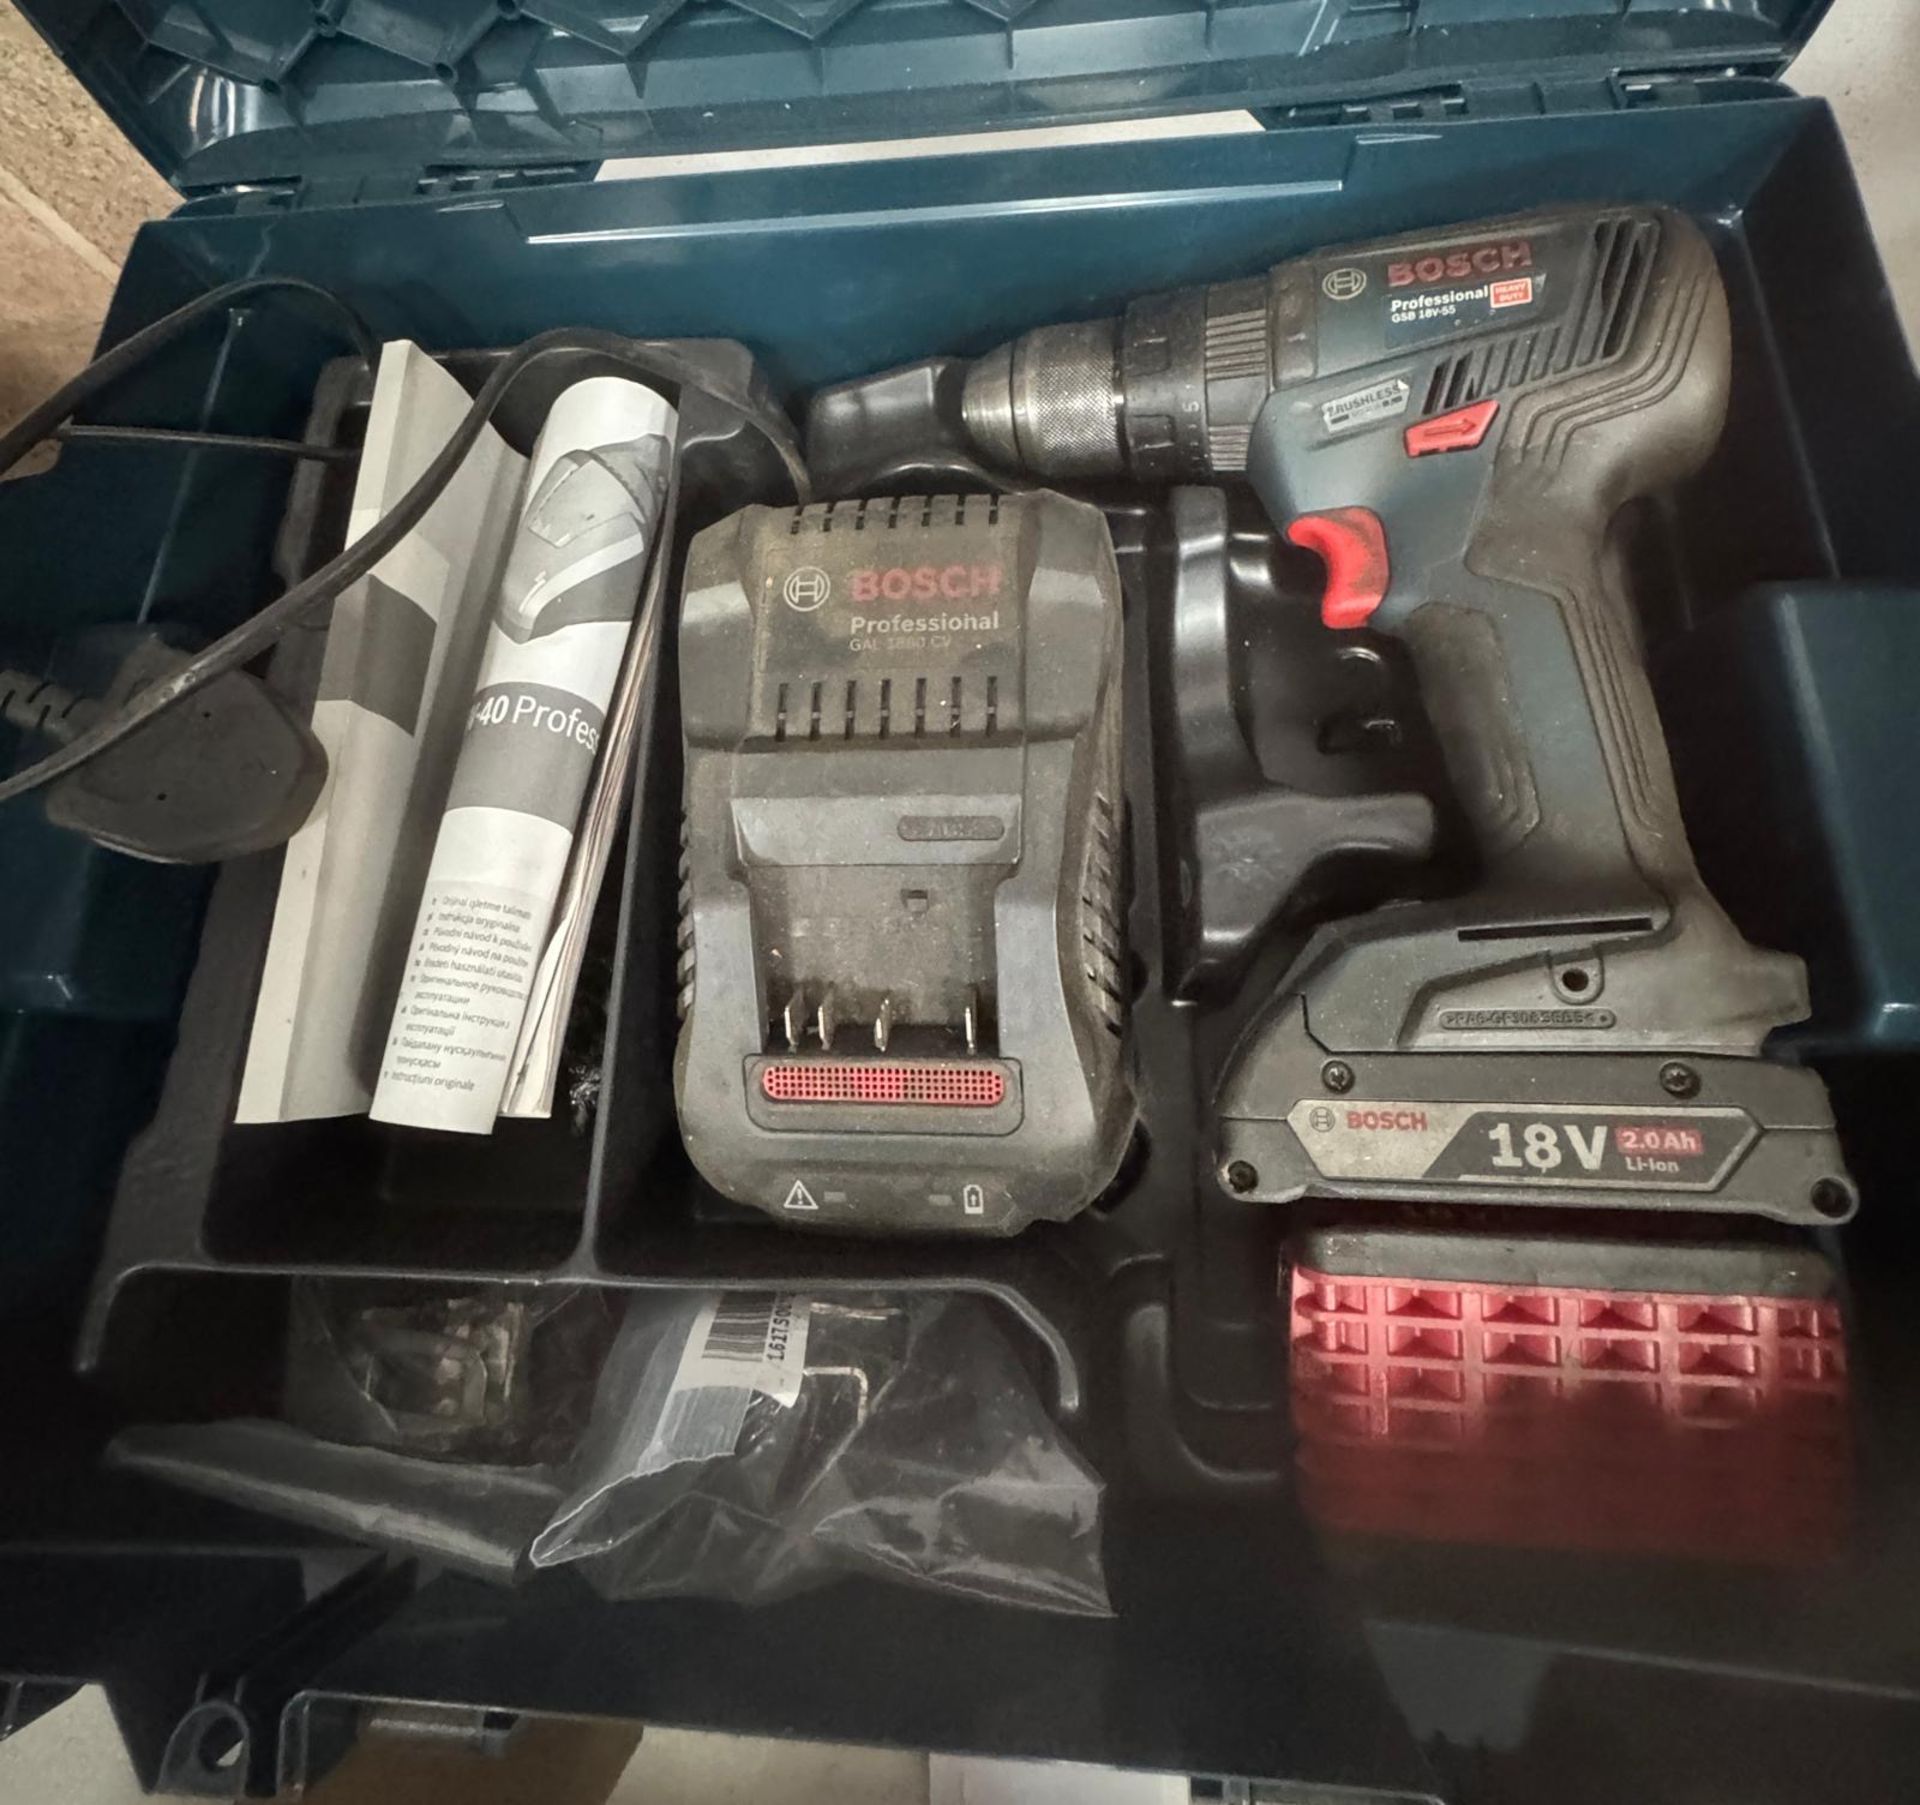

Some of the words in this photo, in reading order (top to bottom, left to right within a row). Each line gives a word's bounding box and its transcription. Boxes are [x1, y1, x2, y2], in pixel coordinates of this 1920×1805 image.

[1387, 241, 1532, 287] BOSCH
[1390, 285, 1488, 312] Professional
[1391, 310, 1416, 323] GSB
[1418, 304, 1456, 319] 18V-55
[851, 562, 1002, 602] BOSCH
[851, 611, 999, 635] Professional
[1345, 1110, 1428, 1132] BOSCH
[1624, 1155, 1680, 1173] Li-Ion
